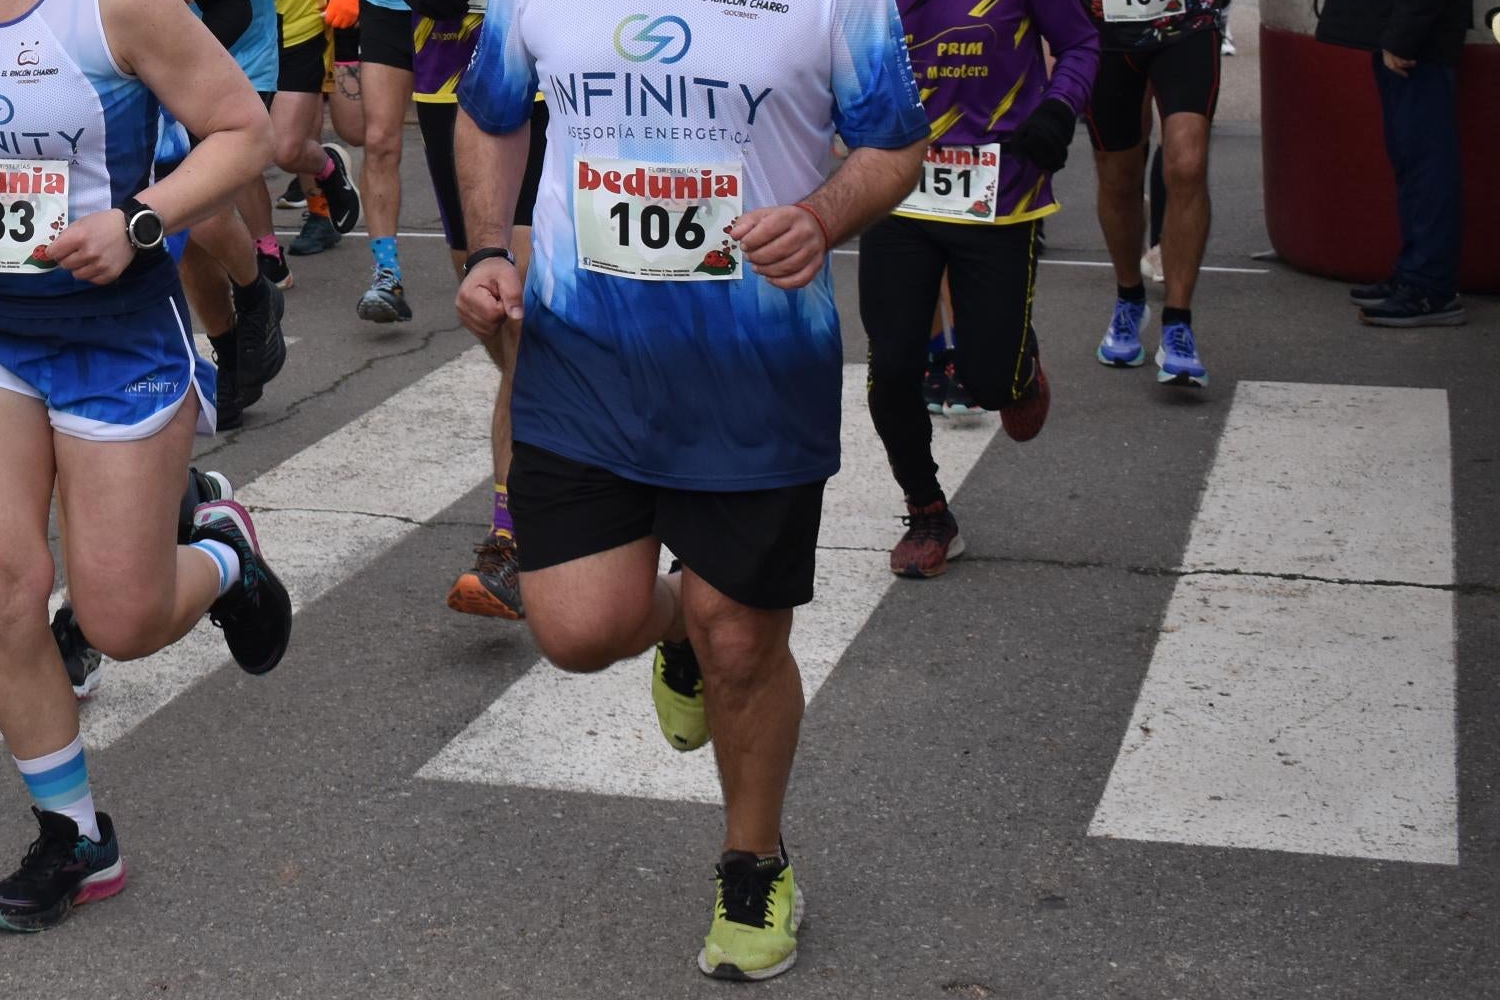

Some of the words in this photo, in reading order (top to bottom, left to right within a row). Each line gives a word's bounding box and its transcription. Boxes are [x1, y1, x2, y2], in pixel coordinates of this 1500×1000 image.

[937, 41, 984, 57] PRIM
[1, 70, 8, 78] EL
[32, 67, 59, 77] CHARRO
[926, 63, 989, 79] Macotera
[550, 71, 773, 126] INFINITY
[578, 161, 738, 199] bedunia
[920, 166, 972, 198] 151
[610, 202, 706, 250] 106
[124, 381, 180, 393] INFINITY
